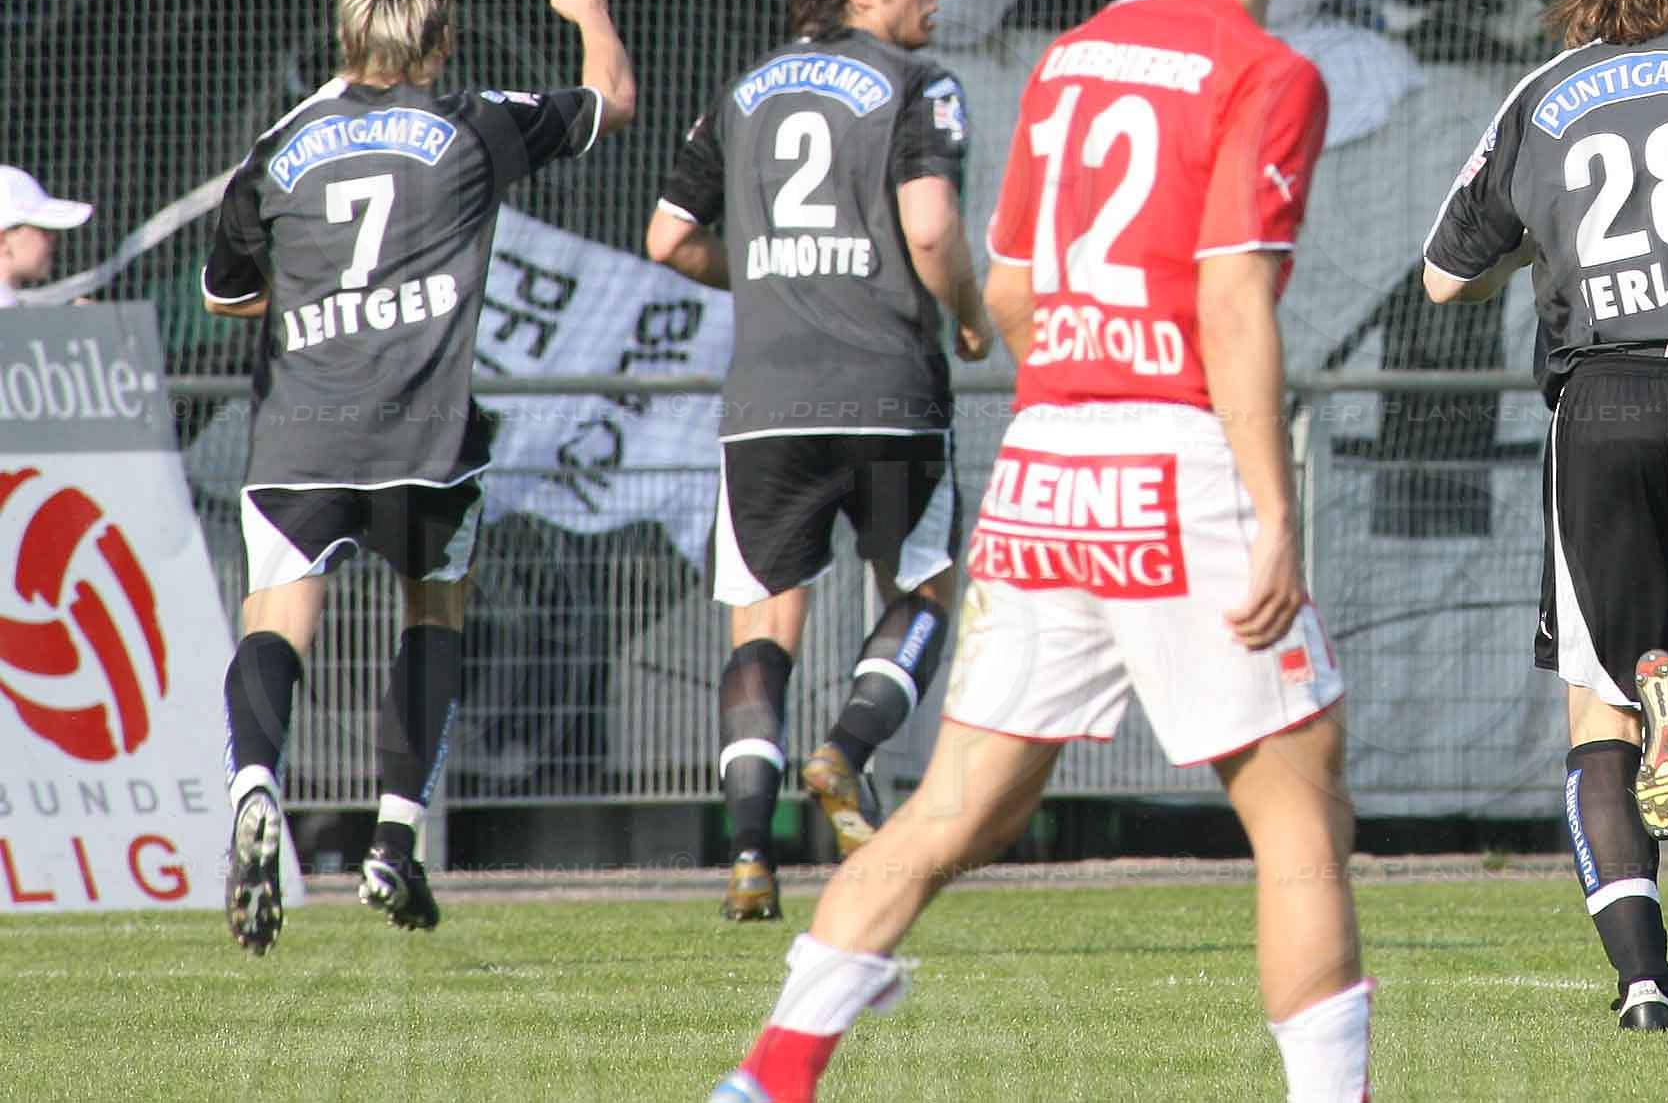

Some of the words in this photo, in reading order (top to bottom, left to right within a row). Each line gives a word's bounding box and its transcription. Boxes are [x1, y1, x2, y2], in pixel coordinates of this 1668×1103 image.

[738, 60, 883, 105] PUNTIGAMER
[275, 116, 446, 181] PUNTIGAMER
[773, 111, 836, 228] 2
[326, 174, 395, 290] 7
[1030, 84, 1159, 308] 12
[284, 273, 459, 352] LEITGEB
[0, 339, 144, 421] obile
[966, 533, 1174, 587] ZEITUNG
